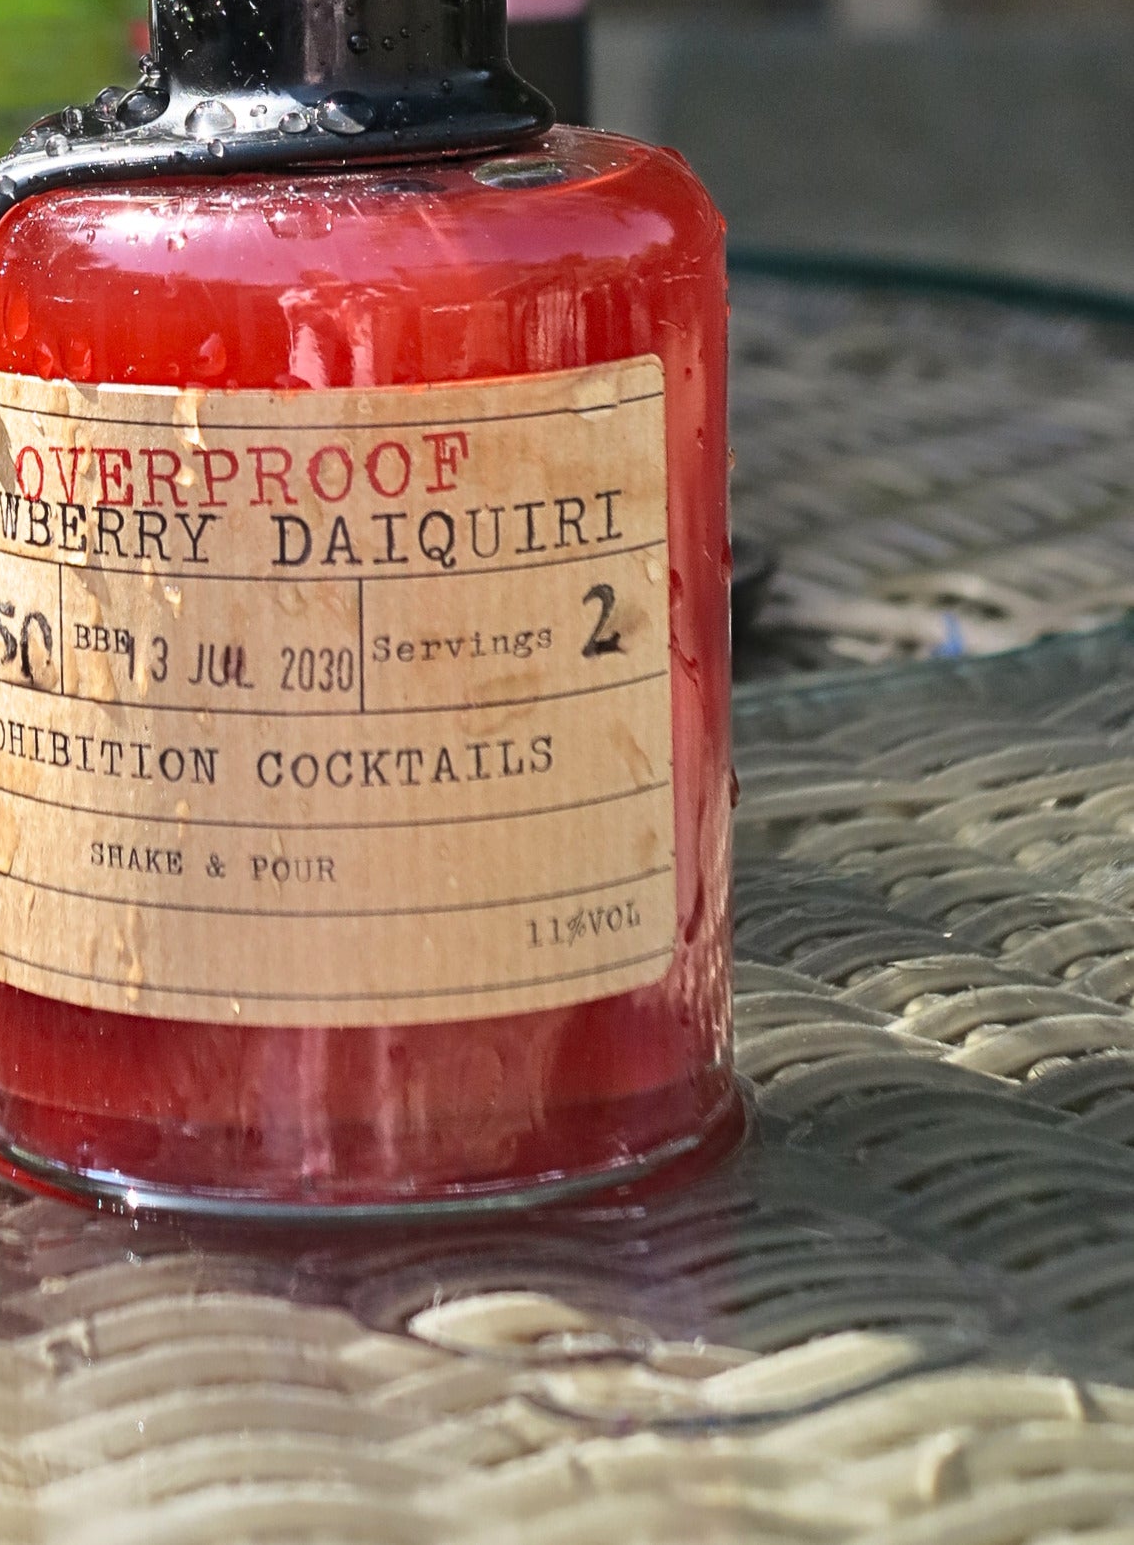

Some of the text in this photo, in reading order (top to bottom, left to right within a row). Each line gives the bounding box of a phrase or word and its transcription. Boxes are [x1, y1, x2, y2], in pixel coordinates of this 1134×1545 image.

[15, 431, 470, 508] OVERPROOF
[269, 489, 623, 569] DAIQUIRI
[372, 583, 623, 663] Servings 2
[187, 642, 255, 689] JUL
[279, 646, 355, 693] 2030
[256, 734, 554, 789] COCKTAILS
[90, 842, 337, 884] SHAKE & POUR
